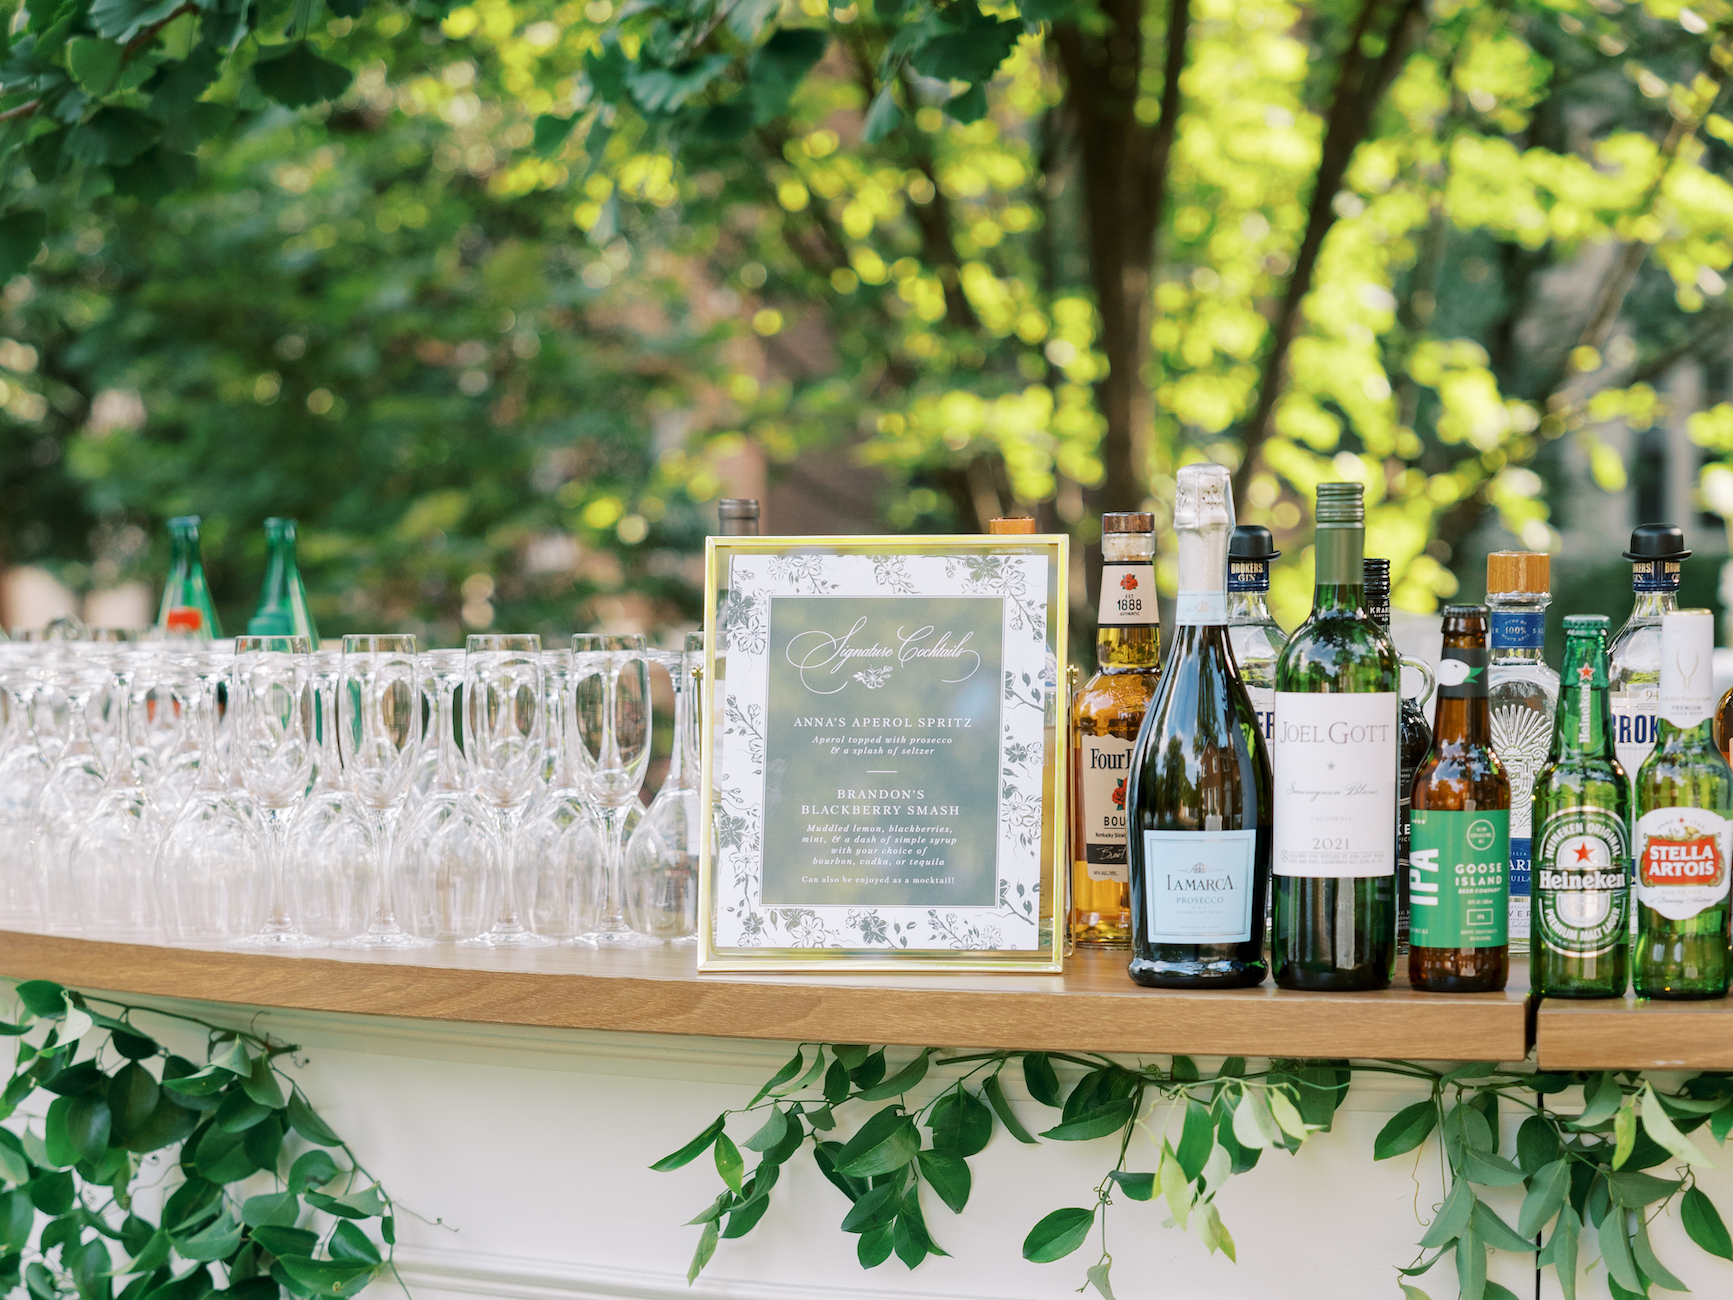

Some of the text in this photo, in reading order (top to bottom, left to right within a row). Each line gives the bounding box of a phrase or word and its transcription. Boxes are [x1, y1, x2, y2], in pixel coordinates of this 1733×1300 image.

[1117, 599, 1142, 610] 1888
[1505, 626, 1527, 634] 100%
[786, 616, 980, 694] Signature Cocktails
[1579, 683, 1591, 743] Heineken
[793, 717, 972, 728] ANNA'S APEROL SPRITZ
[1280, 721, 1324, 743] JOEL
[1328, 721, 1389, 744] GOTT
[812, 736, 953, 746] Aperol topped with prosecco
[830, 746, 840, 754] &
[852, 746, 884, 755] splash
[887, 746, 898, 756] of
[901, 747, 935, 755] seltzer
[1090, 748, 1125, 770] Four
[837, 789, 925, 799] BRANDON'S
[1286, 781, 1379, 803] Sauvignon Blanc
[801, 805, 960, 815] BLACKBERRY SMASH
[806, 824, 953, 834] Muddled lemon, blackberries,
[801, 836, 827, 844] mint,
[880, 836, 892, 845] of
[894, 836, 926, 845] simple
[1313, 838, 1350, 850] 2021
[1545, 822, 1584, 859] HEINEKEN
[831, 846, 928, 856] with your choice of
[1649, 845, 1714, 861] STELLA
[812, 857, 856, 866] bourbon,
[859, 858, 892, 867] vodka,
[909, 858, 945, 867] tequila
[1455, 863, 1502, 874] GOOSE
[1649, 860, 1715, 877] ARTOIS
[801, 875, 819, 883] Can
[821, 875, 840, 883] also
[842, 875, 853, 883] be
[855, 875, 890, 885] enjoyed
[912, 876, 955, 884] mocktail!
[1409, 848, 1439, 906] IPA
[1455, 875, 1503, 887] ISLAND
[1539, 870, 1626, 890] Heineken
[1167, 874, 1234, 892] LAMARCA
[1176, 896, 1224, 904] PROSECCO
[1544, 908, 1578, 941] PREMIUM
[1580, 929, 1603, 941] MALT
[1602, 907, 1621, 933] LAGER
